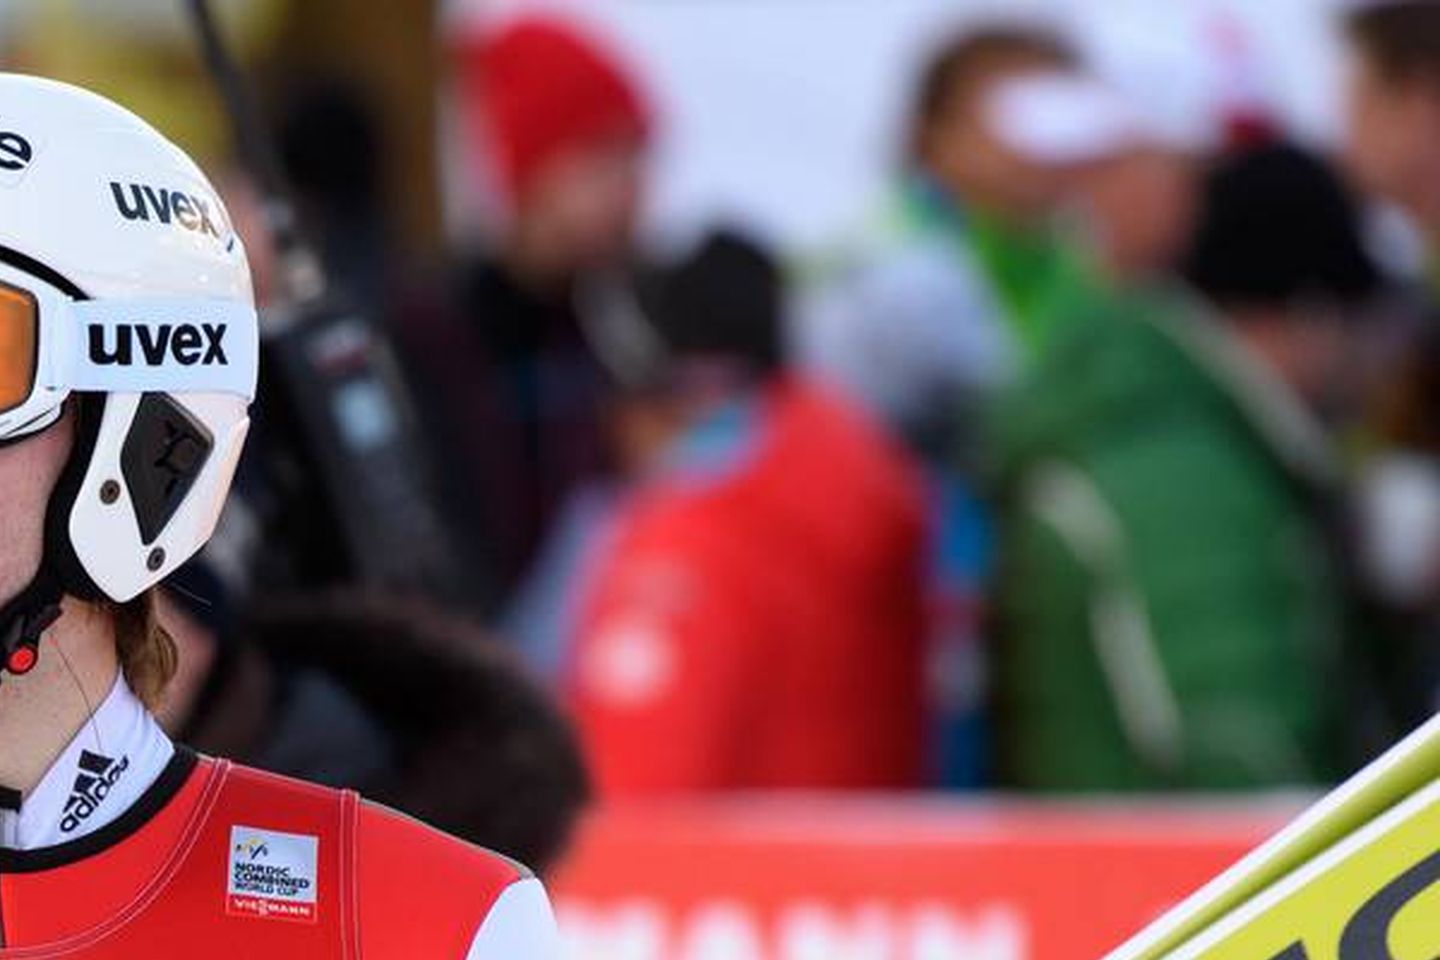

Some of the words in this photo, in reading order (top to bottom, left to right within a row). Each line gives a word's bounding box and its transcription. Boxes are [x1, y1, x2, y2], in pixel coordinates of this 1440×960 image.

[110, 178, 220, 239] uvex
[88, 321, 229, 366] uvex
[60, 754, 130, 832] adidas
[234, 871, 310, 889] COMBINED
